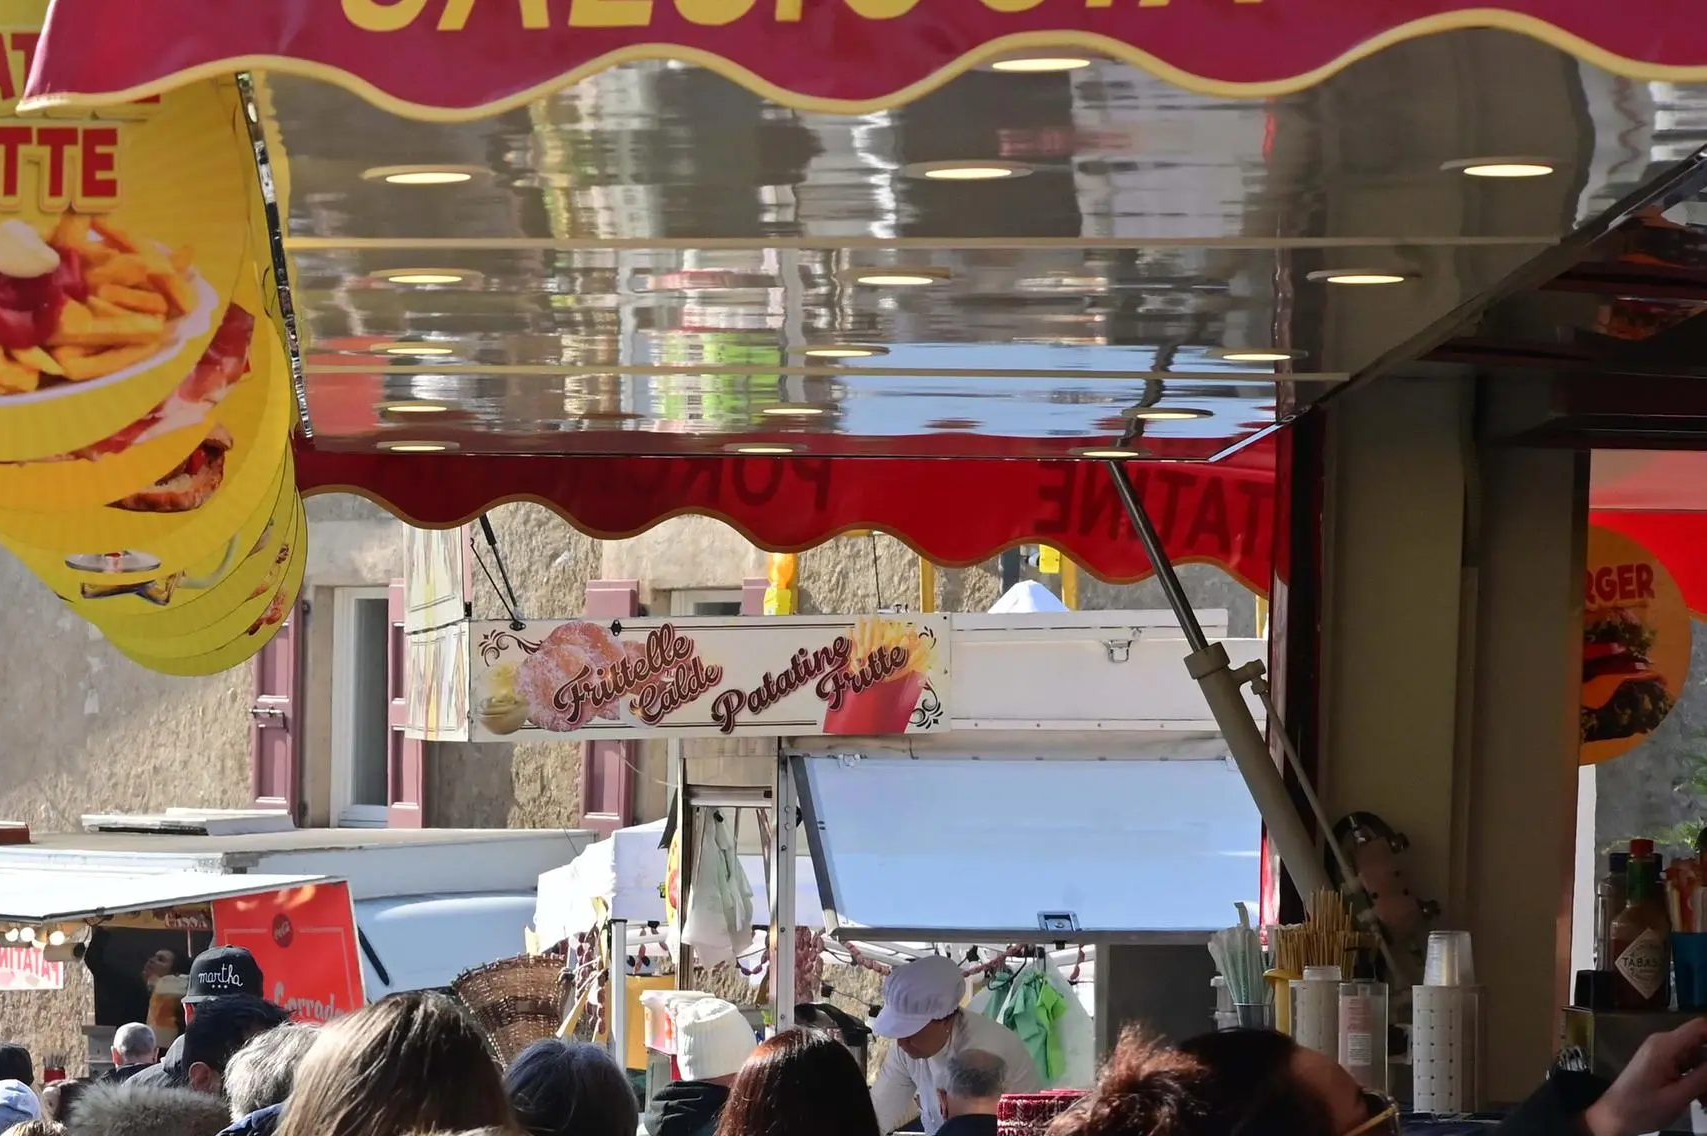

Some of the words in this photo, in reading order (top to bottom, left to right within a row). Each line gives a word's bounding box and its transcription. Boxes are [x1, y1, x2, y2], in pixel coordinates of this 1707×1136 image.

[553, 622, 694, 724] Frittelle
[629, 654, 723, 726] Calde
[711, 635, 853, 735] Patatine
[815, 645, 909, 712] Fritte
[198, 963, 243, 986] martha
